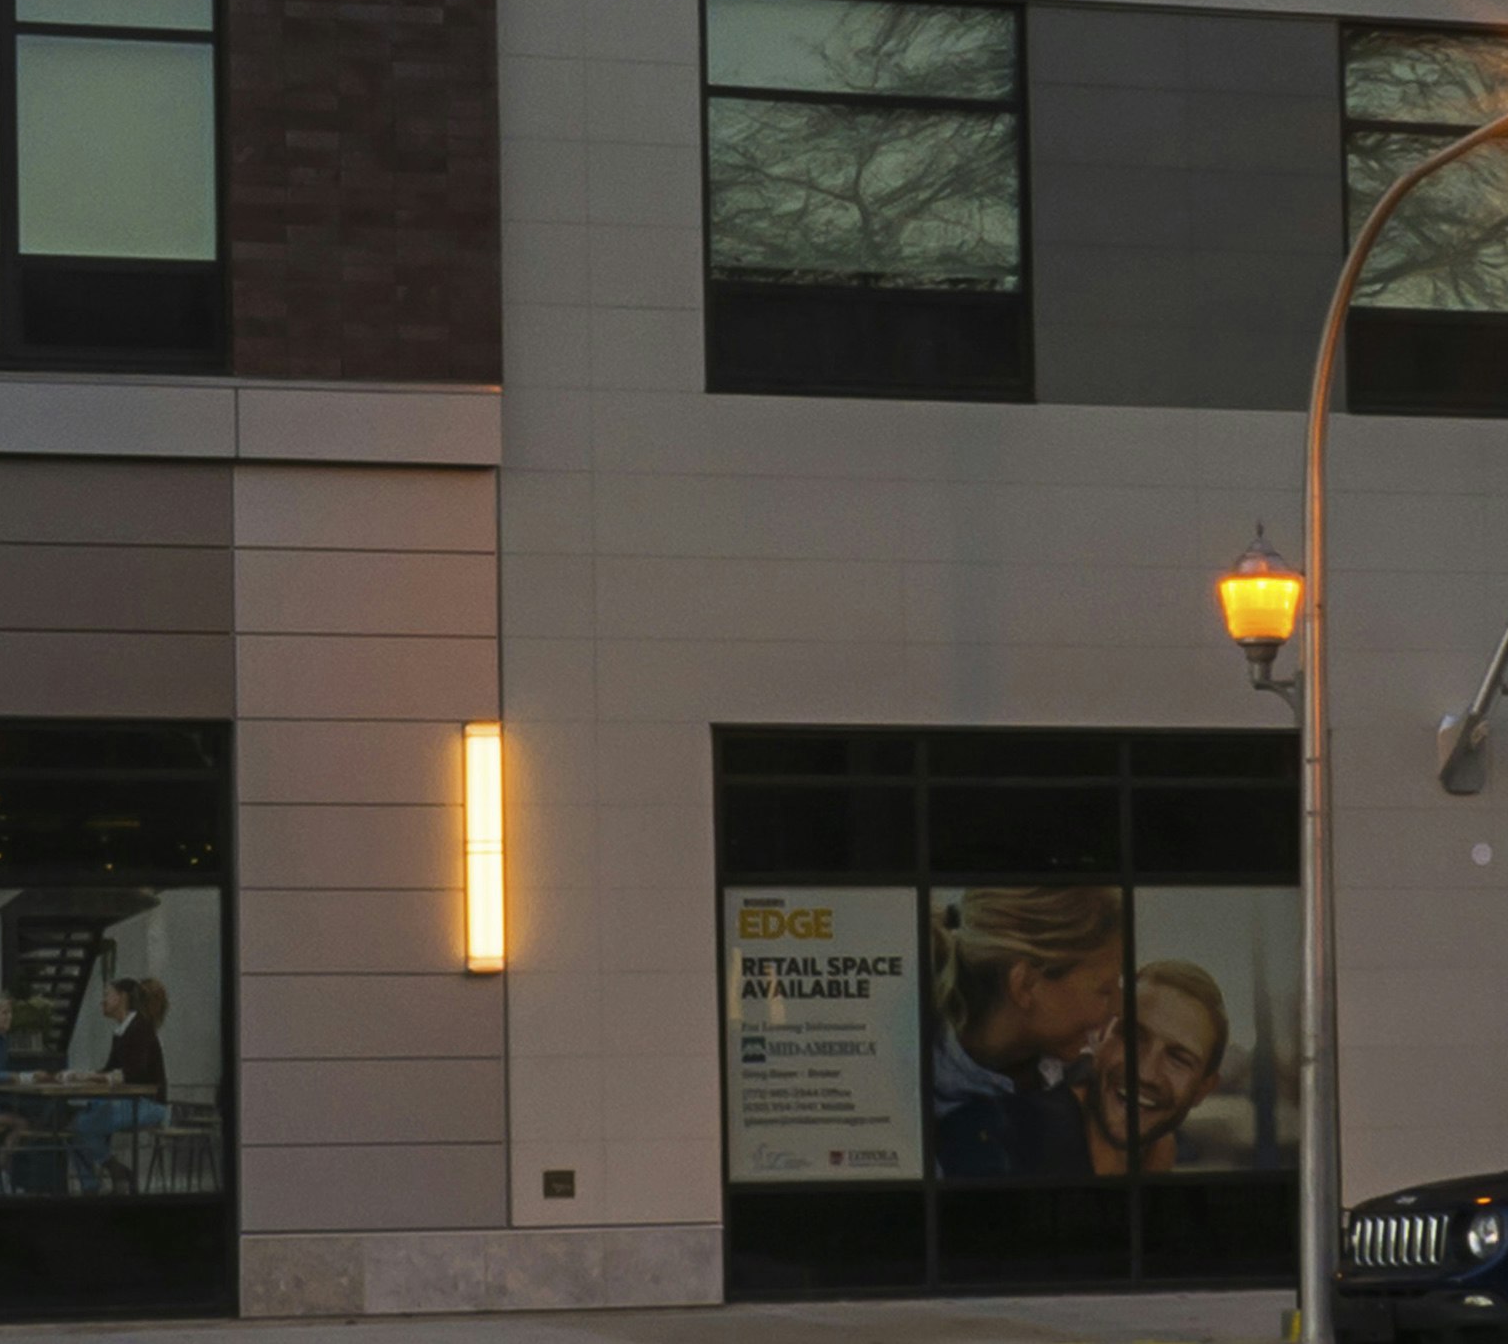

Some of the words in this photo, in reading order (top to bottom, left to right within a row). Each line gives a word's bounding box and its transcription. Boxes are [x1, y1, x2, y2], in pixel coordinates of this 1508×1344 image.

[739, 908, 834, 940] EDGE
[742, 956, 822, 976] RETAIL
[827, 956, 903, 976] SPACE
[742, 978, 870, 999] AVAILABLE
